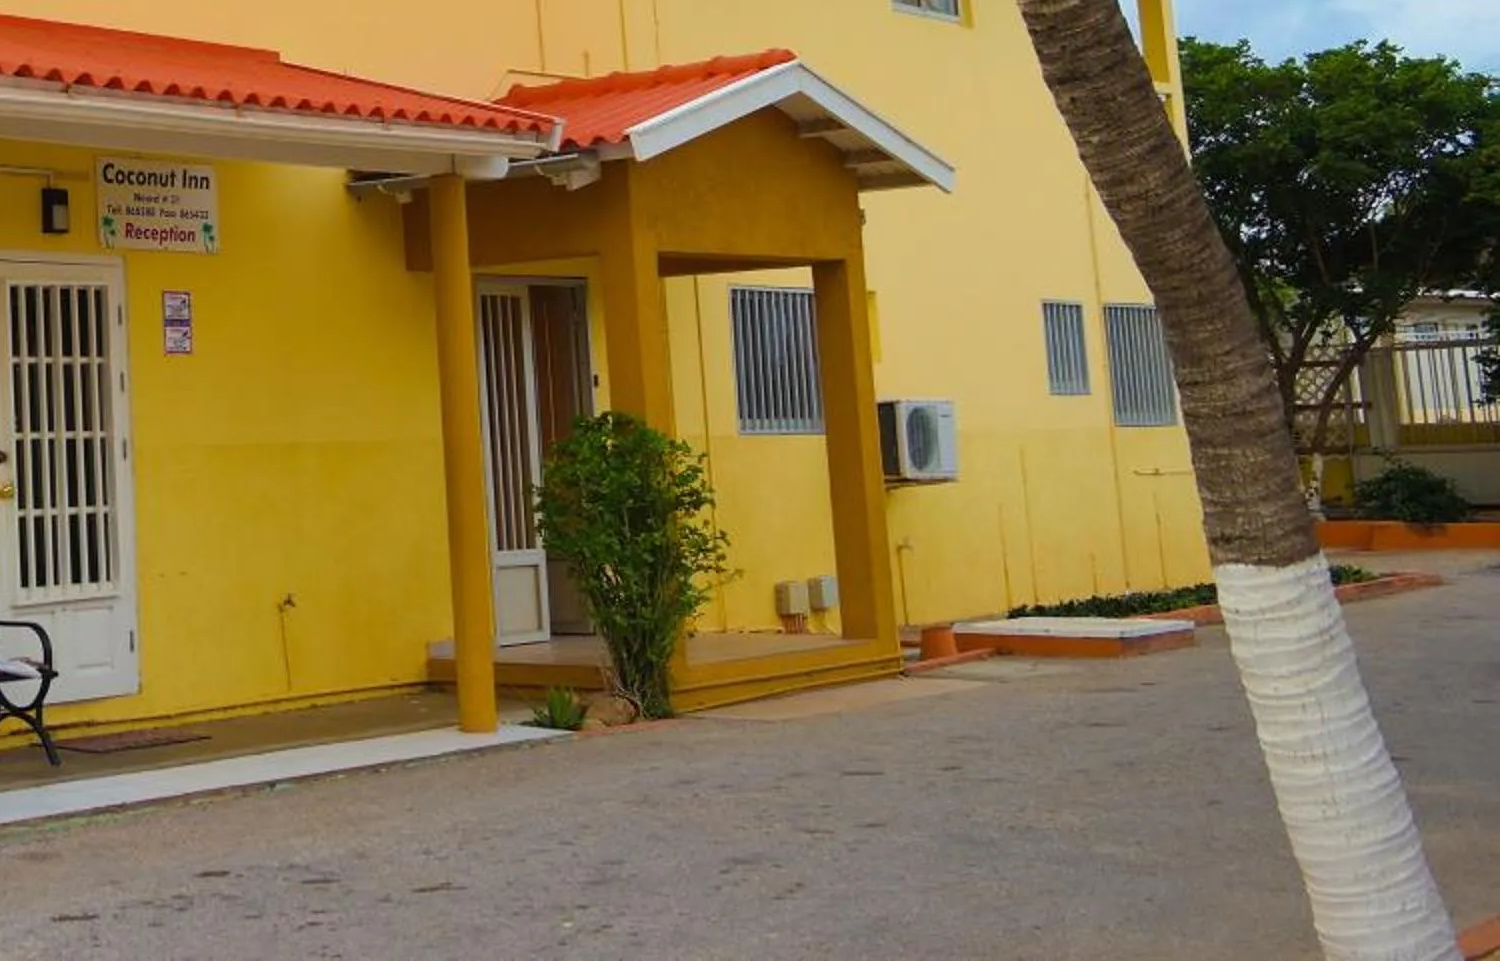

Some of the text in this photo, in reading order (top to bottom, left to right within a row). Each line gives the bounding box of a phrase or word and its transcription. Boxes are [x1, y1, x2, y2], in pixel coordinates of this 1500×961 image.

[102, 163, 210, 189] Coconut Inn
[125, 222, 196, 245] Reception
